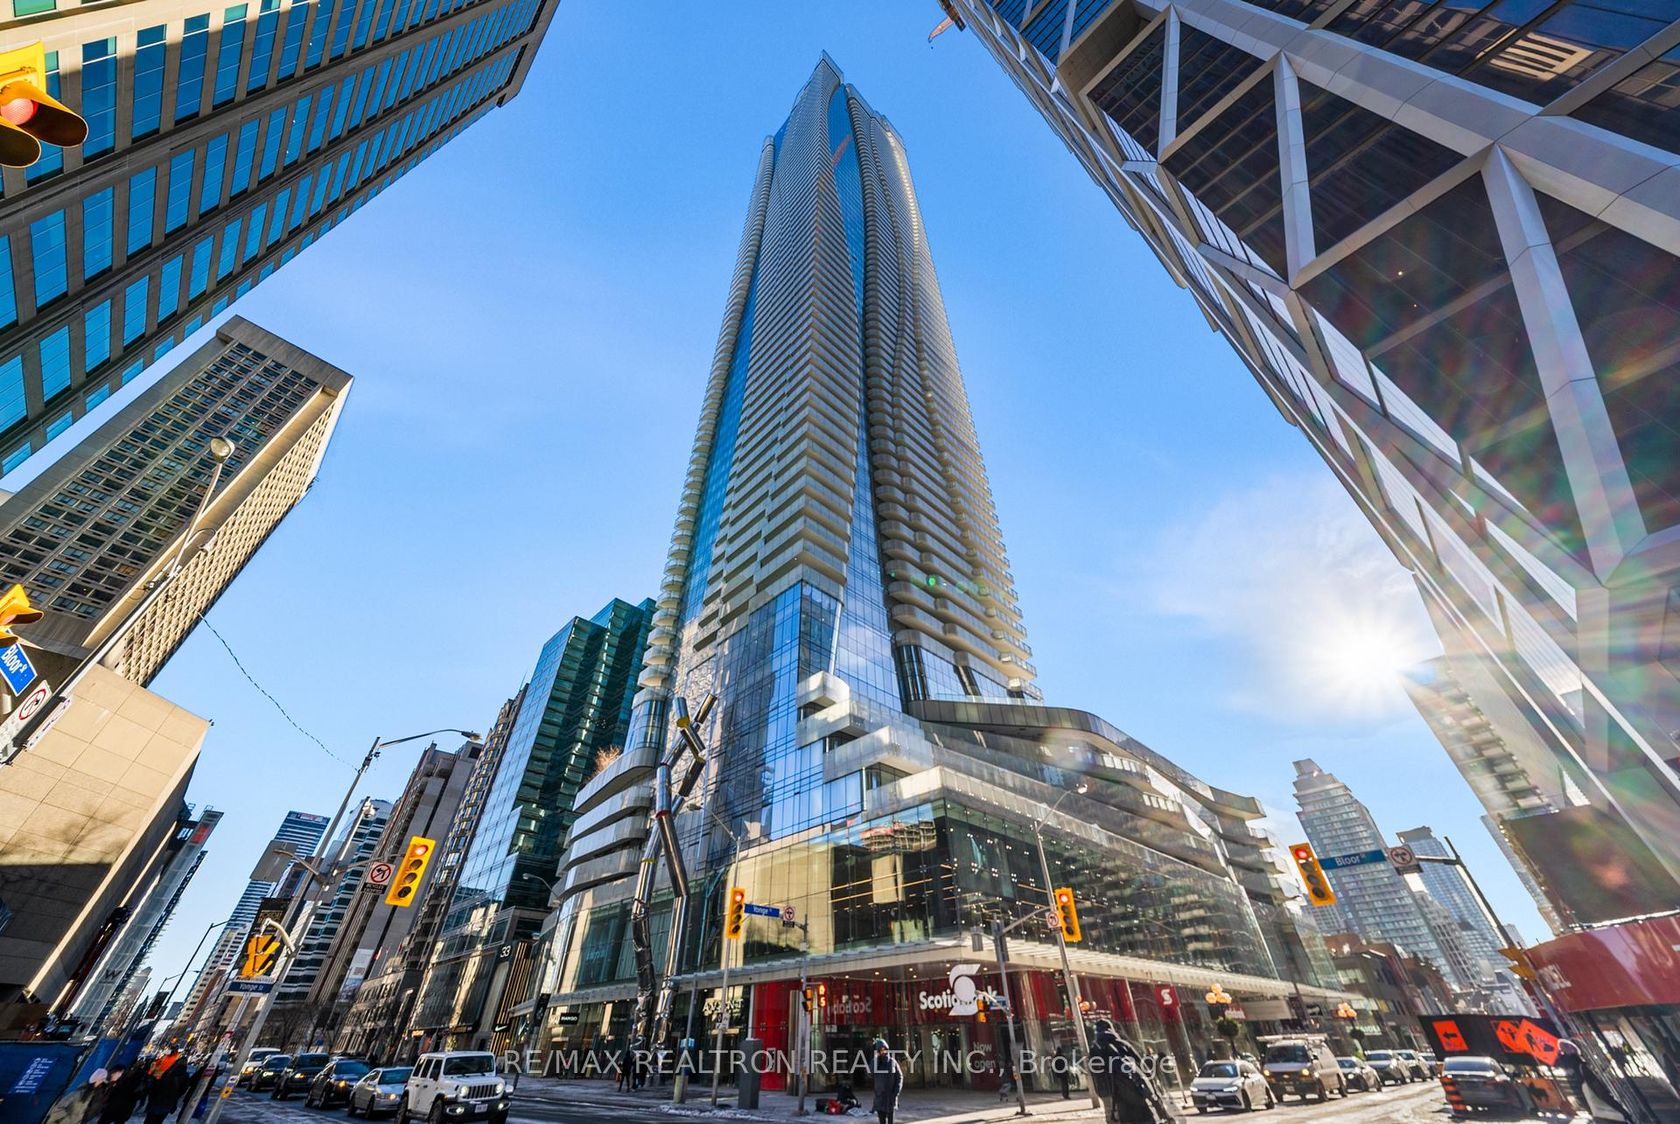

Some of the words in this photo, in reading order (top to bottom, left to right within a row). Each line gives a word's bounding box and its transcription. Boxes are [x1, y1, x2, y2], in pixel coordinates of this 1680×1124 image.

[1, 645, 23, 674] Bloor
[1335, 855, 1361, 867] Bloor
[753, 905, 769, 916] Yonge
[500, 945, 511, 957] 33
[240, 983, 259, 991] Yonge
